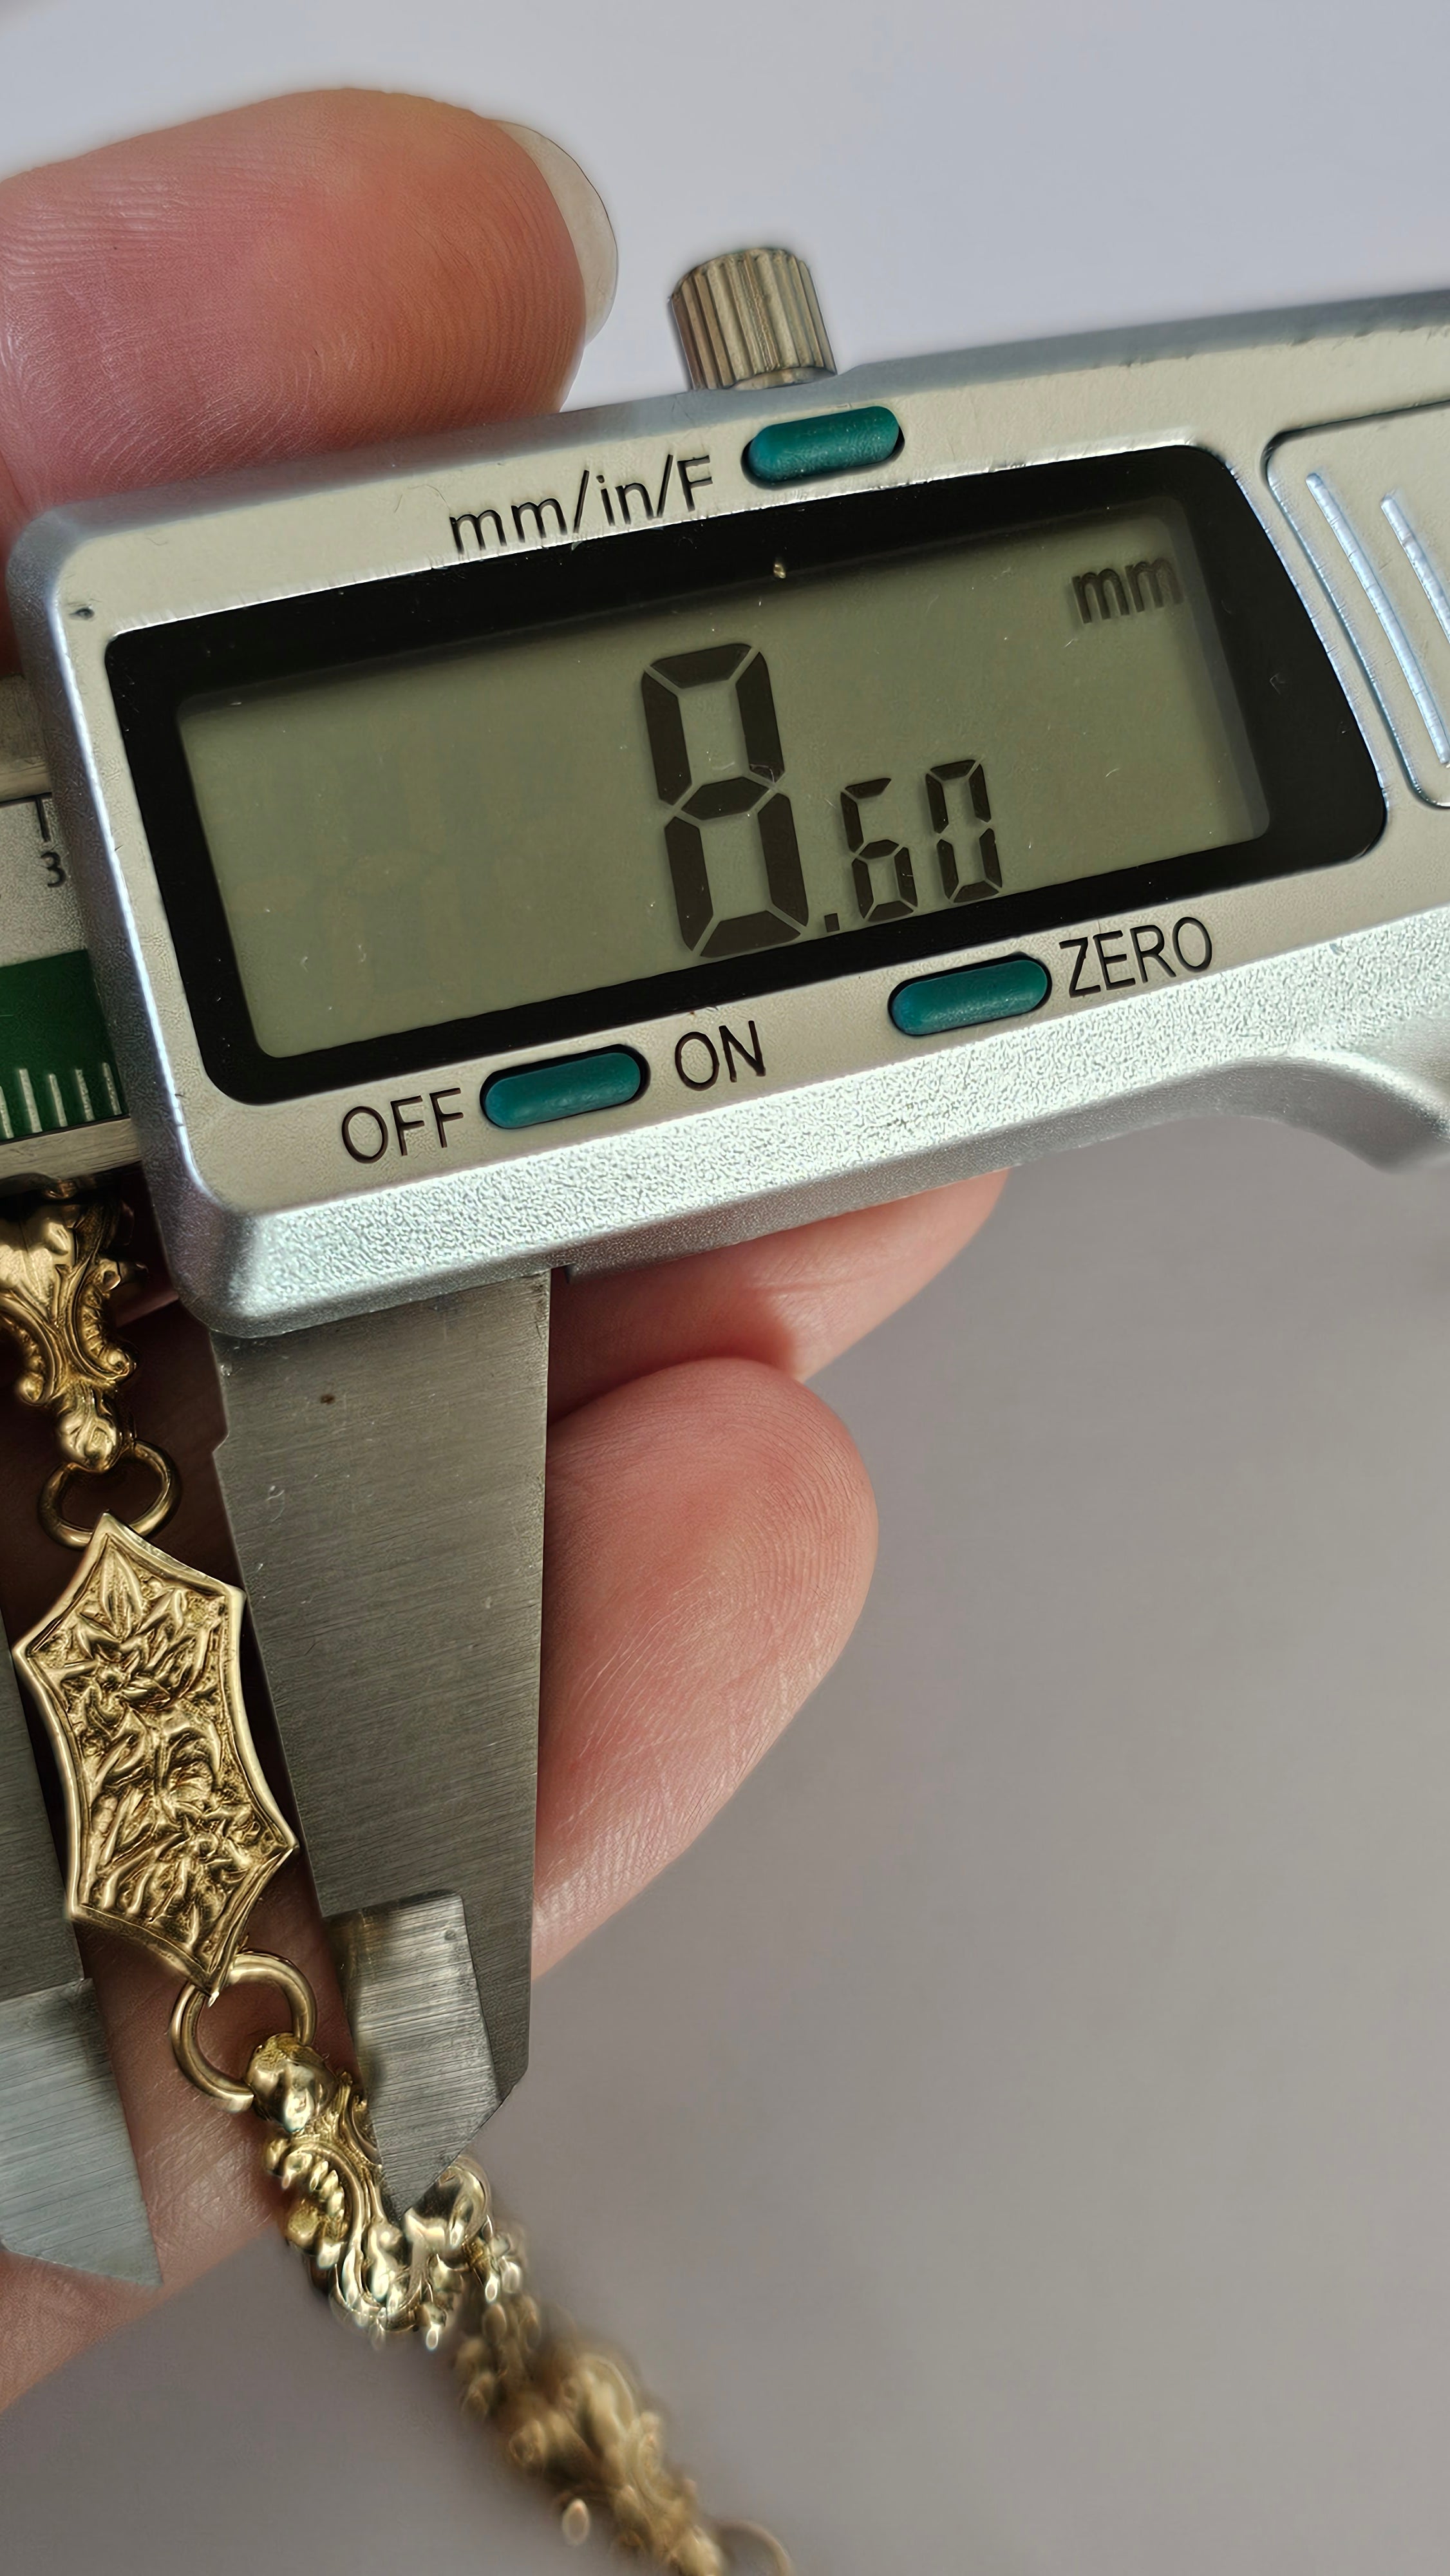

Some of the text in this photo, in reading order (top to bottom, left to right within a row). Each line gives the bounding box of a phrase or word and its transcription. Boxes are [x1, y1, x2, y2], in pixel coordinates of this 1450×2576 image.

[449, 454, 713, 554] mm/in/F
[1071, 556, 1183, 623] mm
[641, 643, 1003, 958] 8.60
[40, 852, 65, 888] 3
[1059, 916, 1212, 998] ZERO
[675, 1020, 766, 1091] ON
[342, 1088, 464, 1163] OFF
